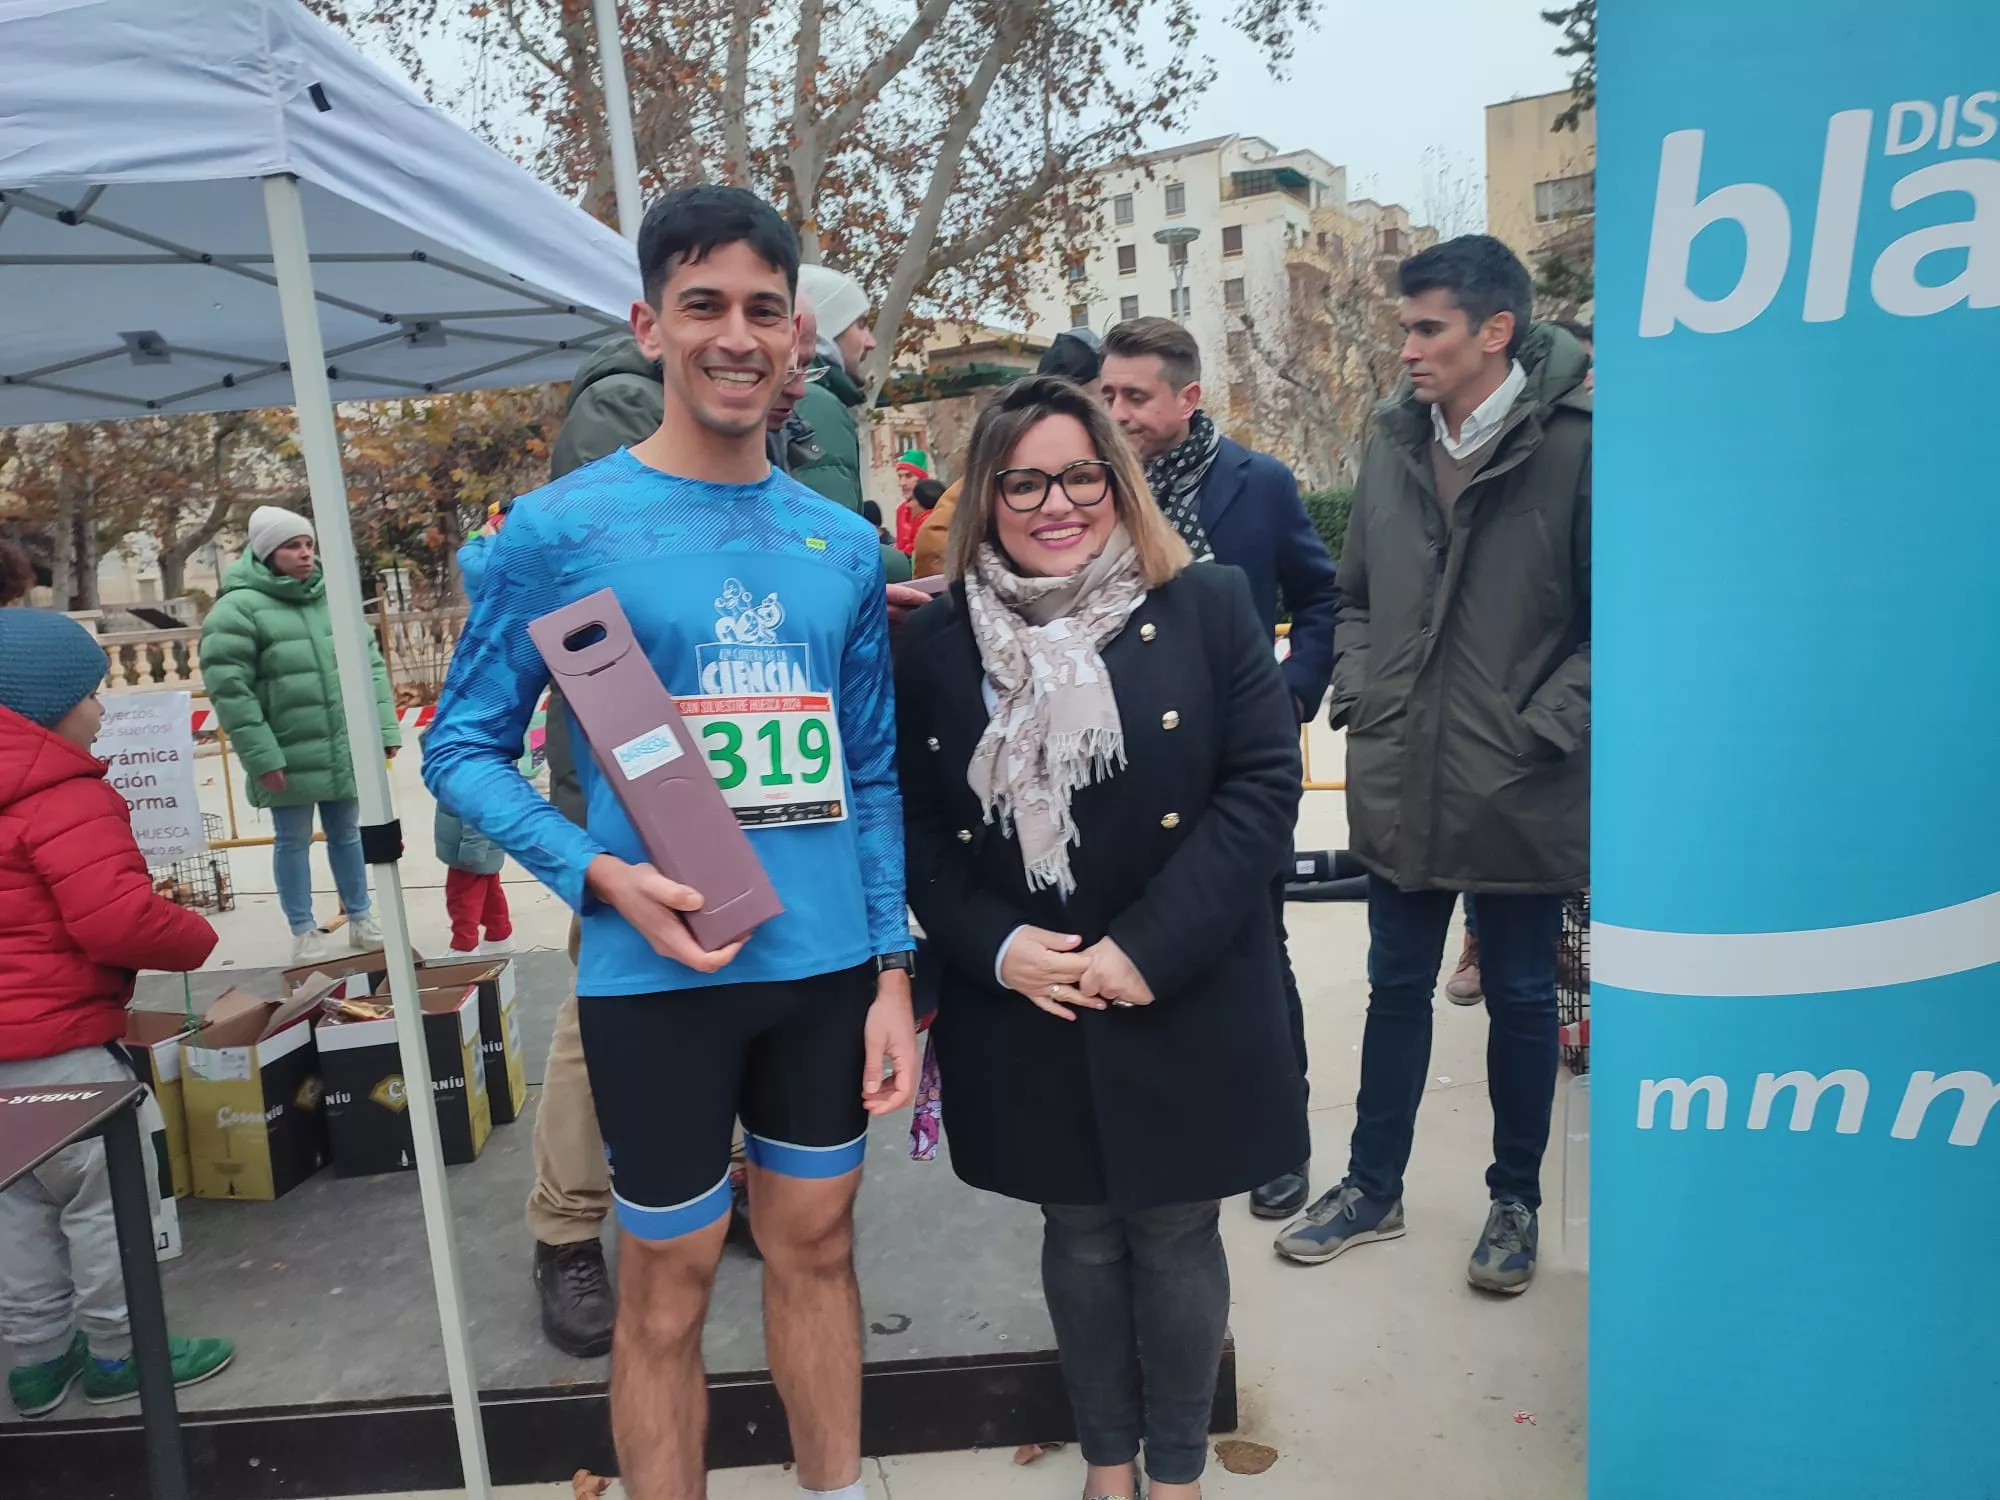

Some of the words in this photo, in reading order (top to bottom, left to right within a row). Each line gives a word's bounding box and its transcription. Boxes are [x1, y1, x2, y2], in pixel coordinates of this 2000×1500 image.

[1884, 90, 2000, 156] DIS
[1638, 109, 2000, 338] bla
[702, 660, 808, 695] CIENCIA
[680, 701, 699, 713] SAN
[700, 699, 748, 713] SILVESTRE
[98, 748, 179, 766] erámica
[702, 718, 831, 790] 319
[103, 771, 157, 789] ción
[126, 796, 178, 811] orma
[8, 1090, 103, 1105] AMBAR
[325, 1090, 351, 1106] NÍU
